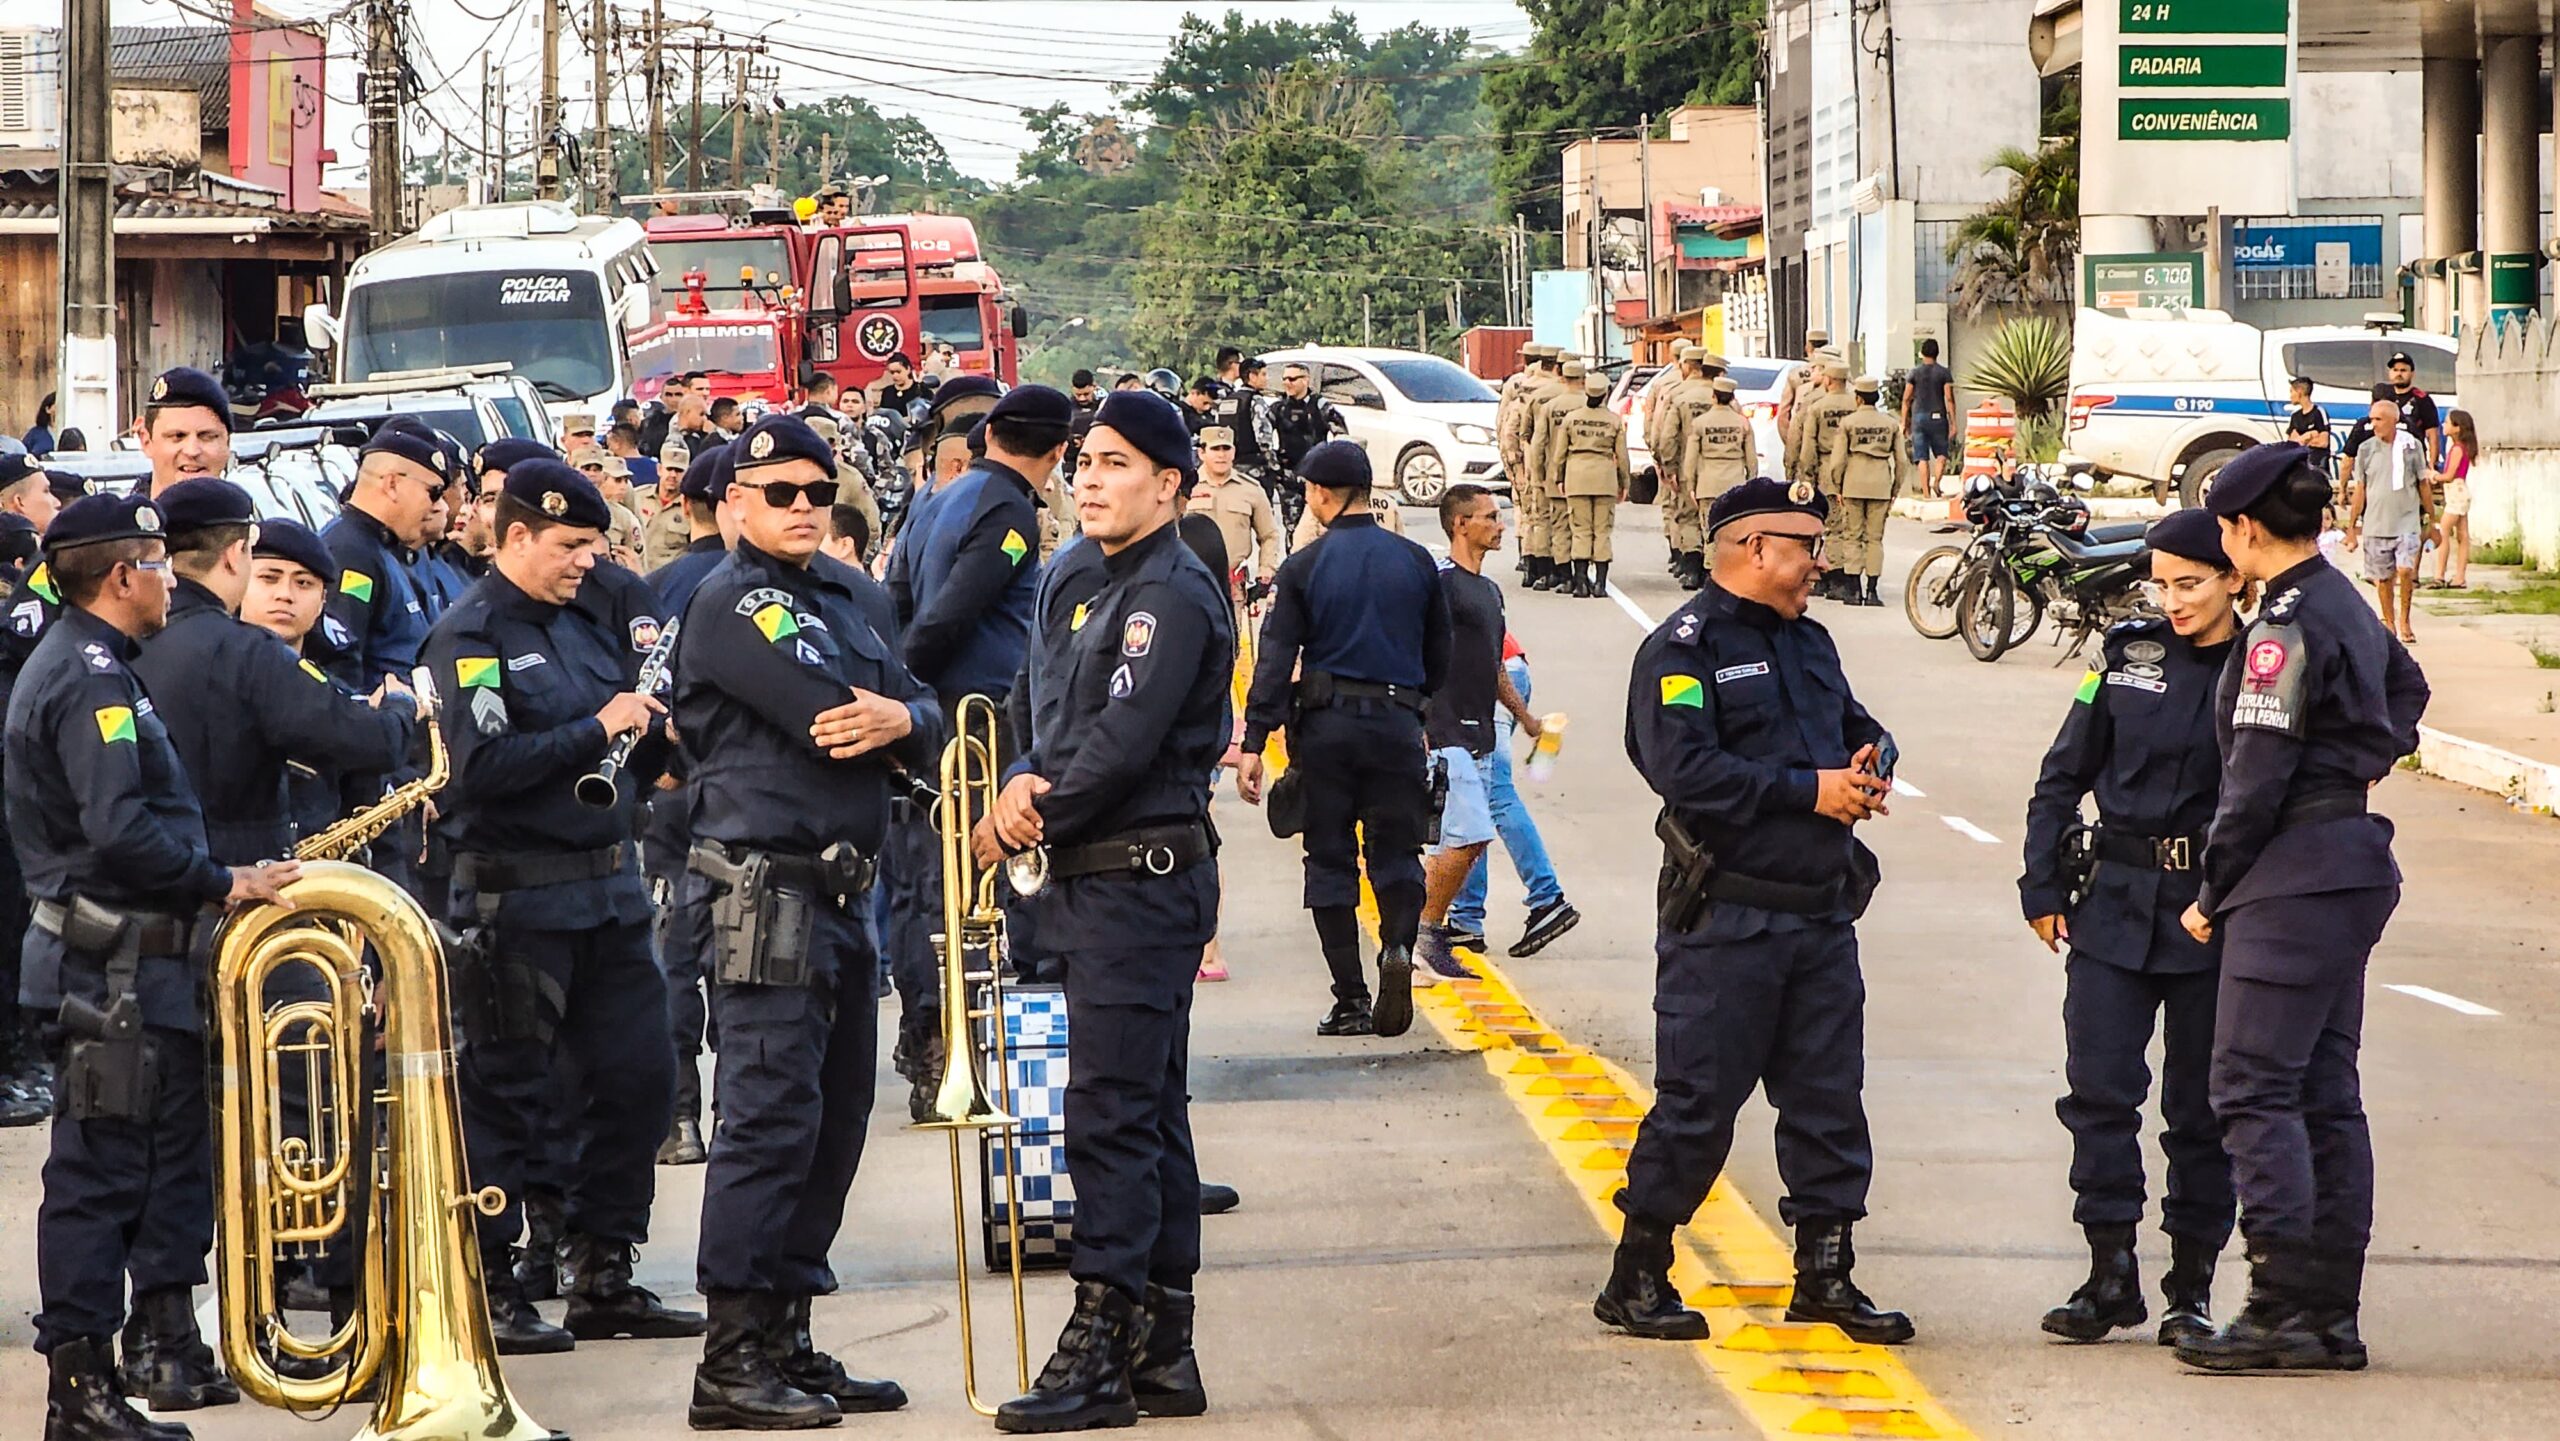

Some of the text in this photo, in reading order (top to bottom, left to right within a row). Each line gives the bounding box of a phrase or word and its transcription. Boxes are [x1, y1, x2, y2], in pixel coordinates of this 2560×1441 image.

[2131, 4, 2170, 21] 24 H
[2130, 57, 2202, 75] PADARIA
[2131, 109, 2258, 131] CONVENIÊNCIA
[501, 275, 568, 291] POLÍCIA
[501, 289, 571, 304] MILITAR
[2189, 399, 2214, 411] 190
[1705, 427, 1740, 435] BOMBEIRO
[1708, 435, 1738, 444] MILITAR
[2236, 694, 2281, 710] ATRULHA
[2256, 709, 2290, 730] PENHA
